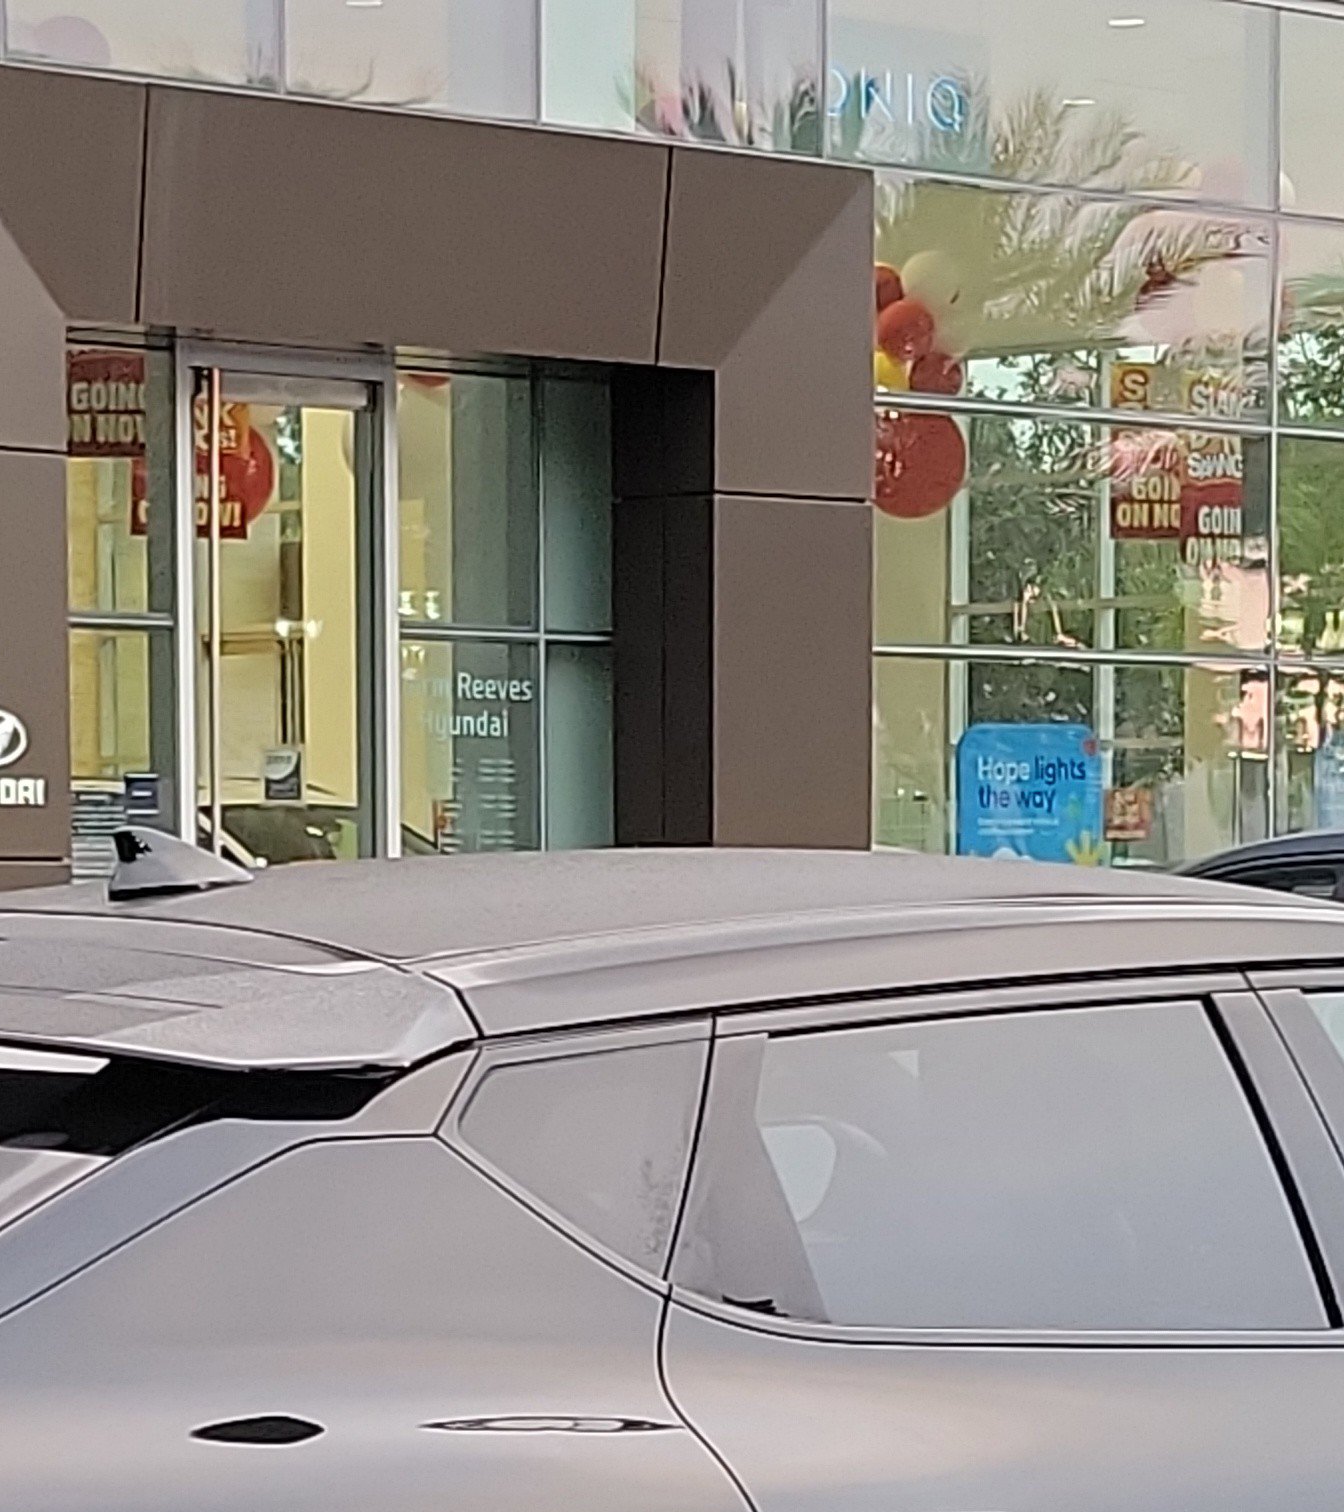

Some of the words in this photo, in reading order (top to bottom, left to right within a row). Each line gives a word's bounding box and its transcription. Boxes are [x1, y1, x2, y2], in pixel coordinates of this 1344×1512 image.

[457, 671, 533, 701] Reeves
[977, 755, 1030, 785] Hope
[1034, 755, 1086, 785] lights
[978, 784, 1010, 809] the
[1017, 789, 1056, 814] way
